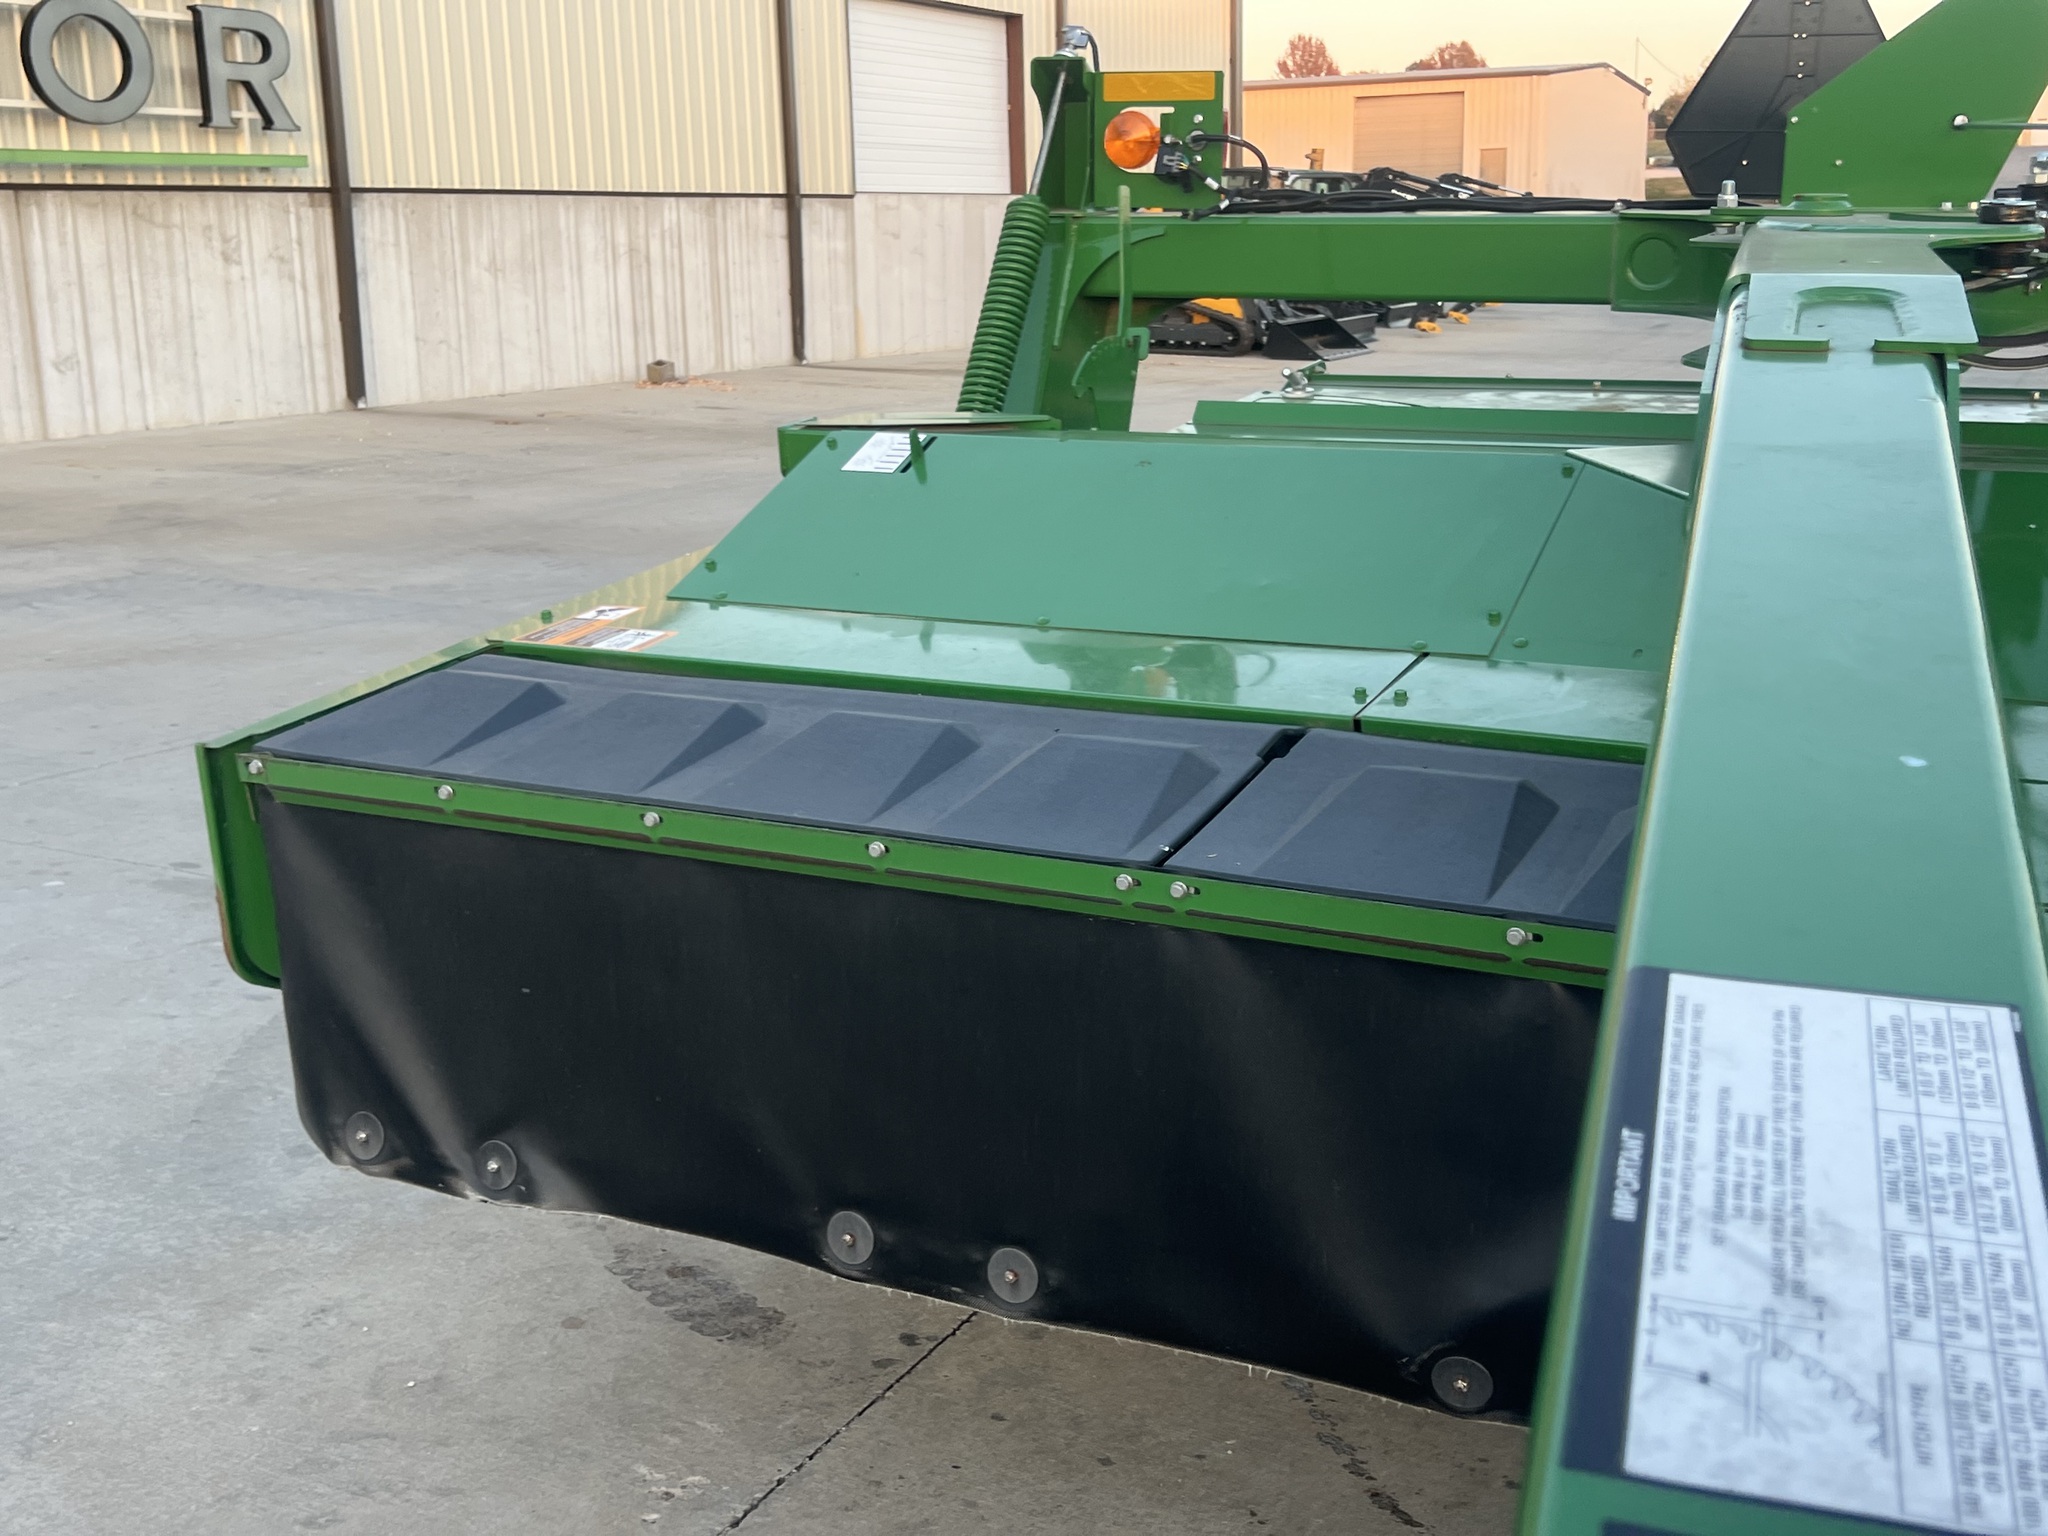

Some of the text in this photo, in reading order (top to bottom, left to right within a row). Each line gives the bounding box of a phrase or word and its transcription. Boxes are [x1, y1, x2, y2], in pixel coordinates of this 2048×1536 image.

[20, 0, 301, 132] OR
[1672, 994, 1687, 1024] DAMAGE
[1773, 1022, 1785, 1046] HITCH
[1789, 1044, 1803, 1060] ARE
[1687, 1048, 1702, 1070] REAR
[1873, 1024, 1892, 1082] LARGE TURN
[1889, 1013, 1911, 1097] LIMITER REQUIRED
[1665, 1067, 1681, 1104] PREVENT
[1686, 1071, 1700, 1087] THE
[1772, 1059, 1785, 1091] CENTER
[1789, 1061, 1803, 1098] LIMITERS
[1683, 1088, 1699, 1123] BEYOND
[1716, 1085, 1730, 1125] POSITION
[1790, 1099, 1804, 1123] TURN
[1660, 1119, 1677, 1164] REQUIRED
[1680, 1135, 1696, 1162] POINT
[1714, 1126, 1729, 1163] PROPER
[1790, 1134, 1805, 1186] DETERMINE
[1610, 1127, 1646, 1222] IMPORTANT
[1678, 1163, 1694, 1192] HITCH
[1772, 1139, 1785, 1186] DIAMETER
[1881, 1137, 1901, 1203] SMALL TURN
[1899, 1124, 1922, 1223] LIMITER REQUIRED
[1657, 1181, 1672, 1201] MAY
[1711, 1176, 1727, 1224] DRAWBAR
[1771, 1188, 1785, 1213] FULL
[1653, 1201, 1671, 1248] LIMITERS
[1675, 1193, 1693, 1240] TRACTOR
[1771, 1213, 1785, 1242] FROM
[1790, 1201, 1805, 1238] BELOW
[1673, 1241, 1690, 1262] THE
[1710, 1227, 1725, 1247] SET
[1888, 1232, 1907, 1279] LIMITER
[1650, 1250, 1667, 1278] TURN
[1771, 1245, 1785, 1296] MEASURE
[1790, 1240, 1806, 1275] CHART
[1934, 1244, 1955, 1277] THAN
[1985, 1250, 2007, 1285] THAN
[1892, 1281, 1910, 1316] TURN
[1909, 1254, 1931, 1319] REQUIRED
[1937, 1279, 1958, 1311] LESS
[1989, 1286, 2012, 1319] LESS
[1947, 1352, 1968, 1395] HITCH
[2000, 1355, 2024, 1399] HITCH
[1971, 1380, 1994, 1425] HITCH
[1909, 1381, 1934, 1466] HITCH TYPE
[1951, 1398, 1974, 1450] CLEVIS
[2006, 1402, 2032, 1454] CLEVIS
[1976, 1428, 1999, 1466] BALL
[1957, 1454, 1978, 1488] RPM
[2013, 1457, 2037, 1492] RPM
